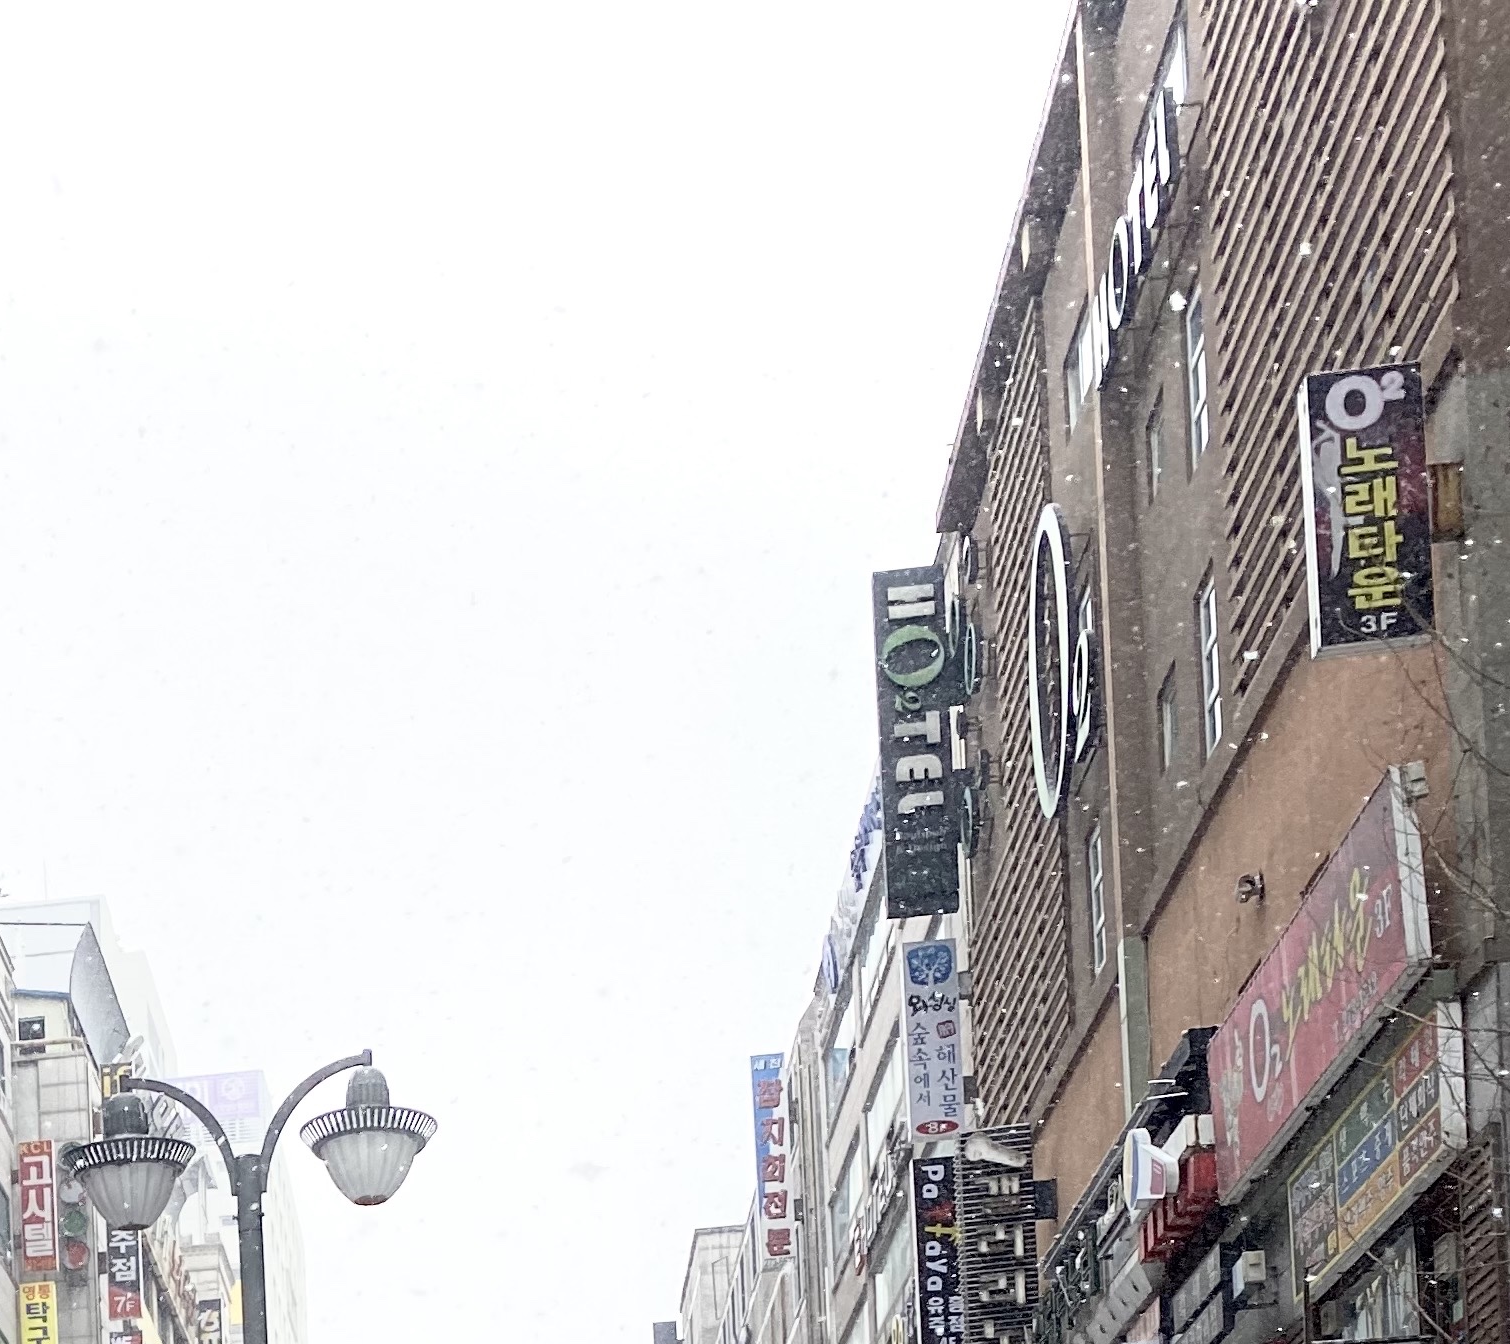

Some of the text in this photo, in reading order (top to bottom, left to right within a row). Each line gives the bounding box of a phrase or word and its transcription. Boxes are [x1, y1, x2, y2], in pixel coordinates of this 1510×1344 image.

[1343, 437, 1401, 611] 노래타운
[1361, 613, 1396, 633] 3F
[908, 1023, 932, 1107] 숲속에서
[937, 1044, 960, 1118] 해산물
[22, 1155, 54, 1257] 고시텔
